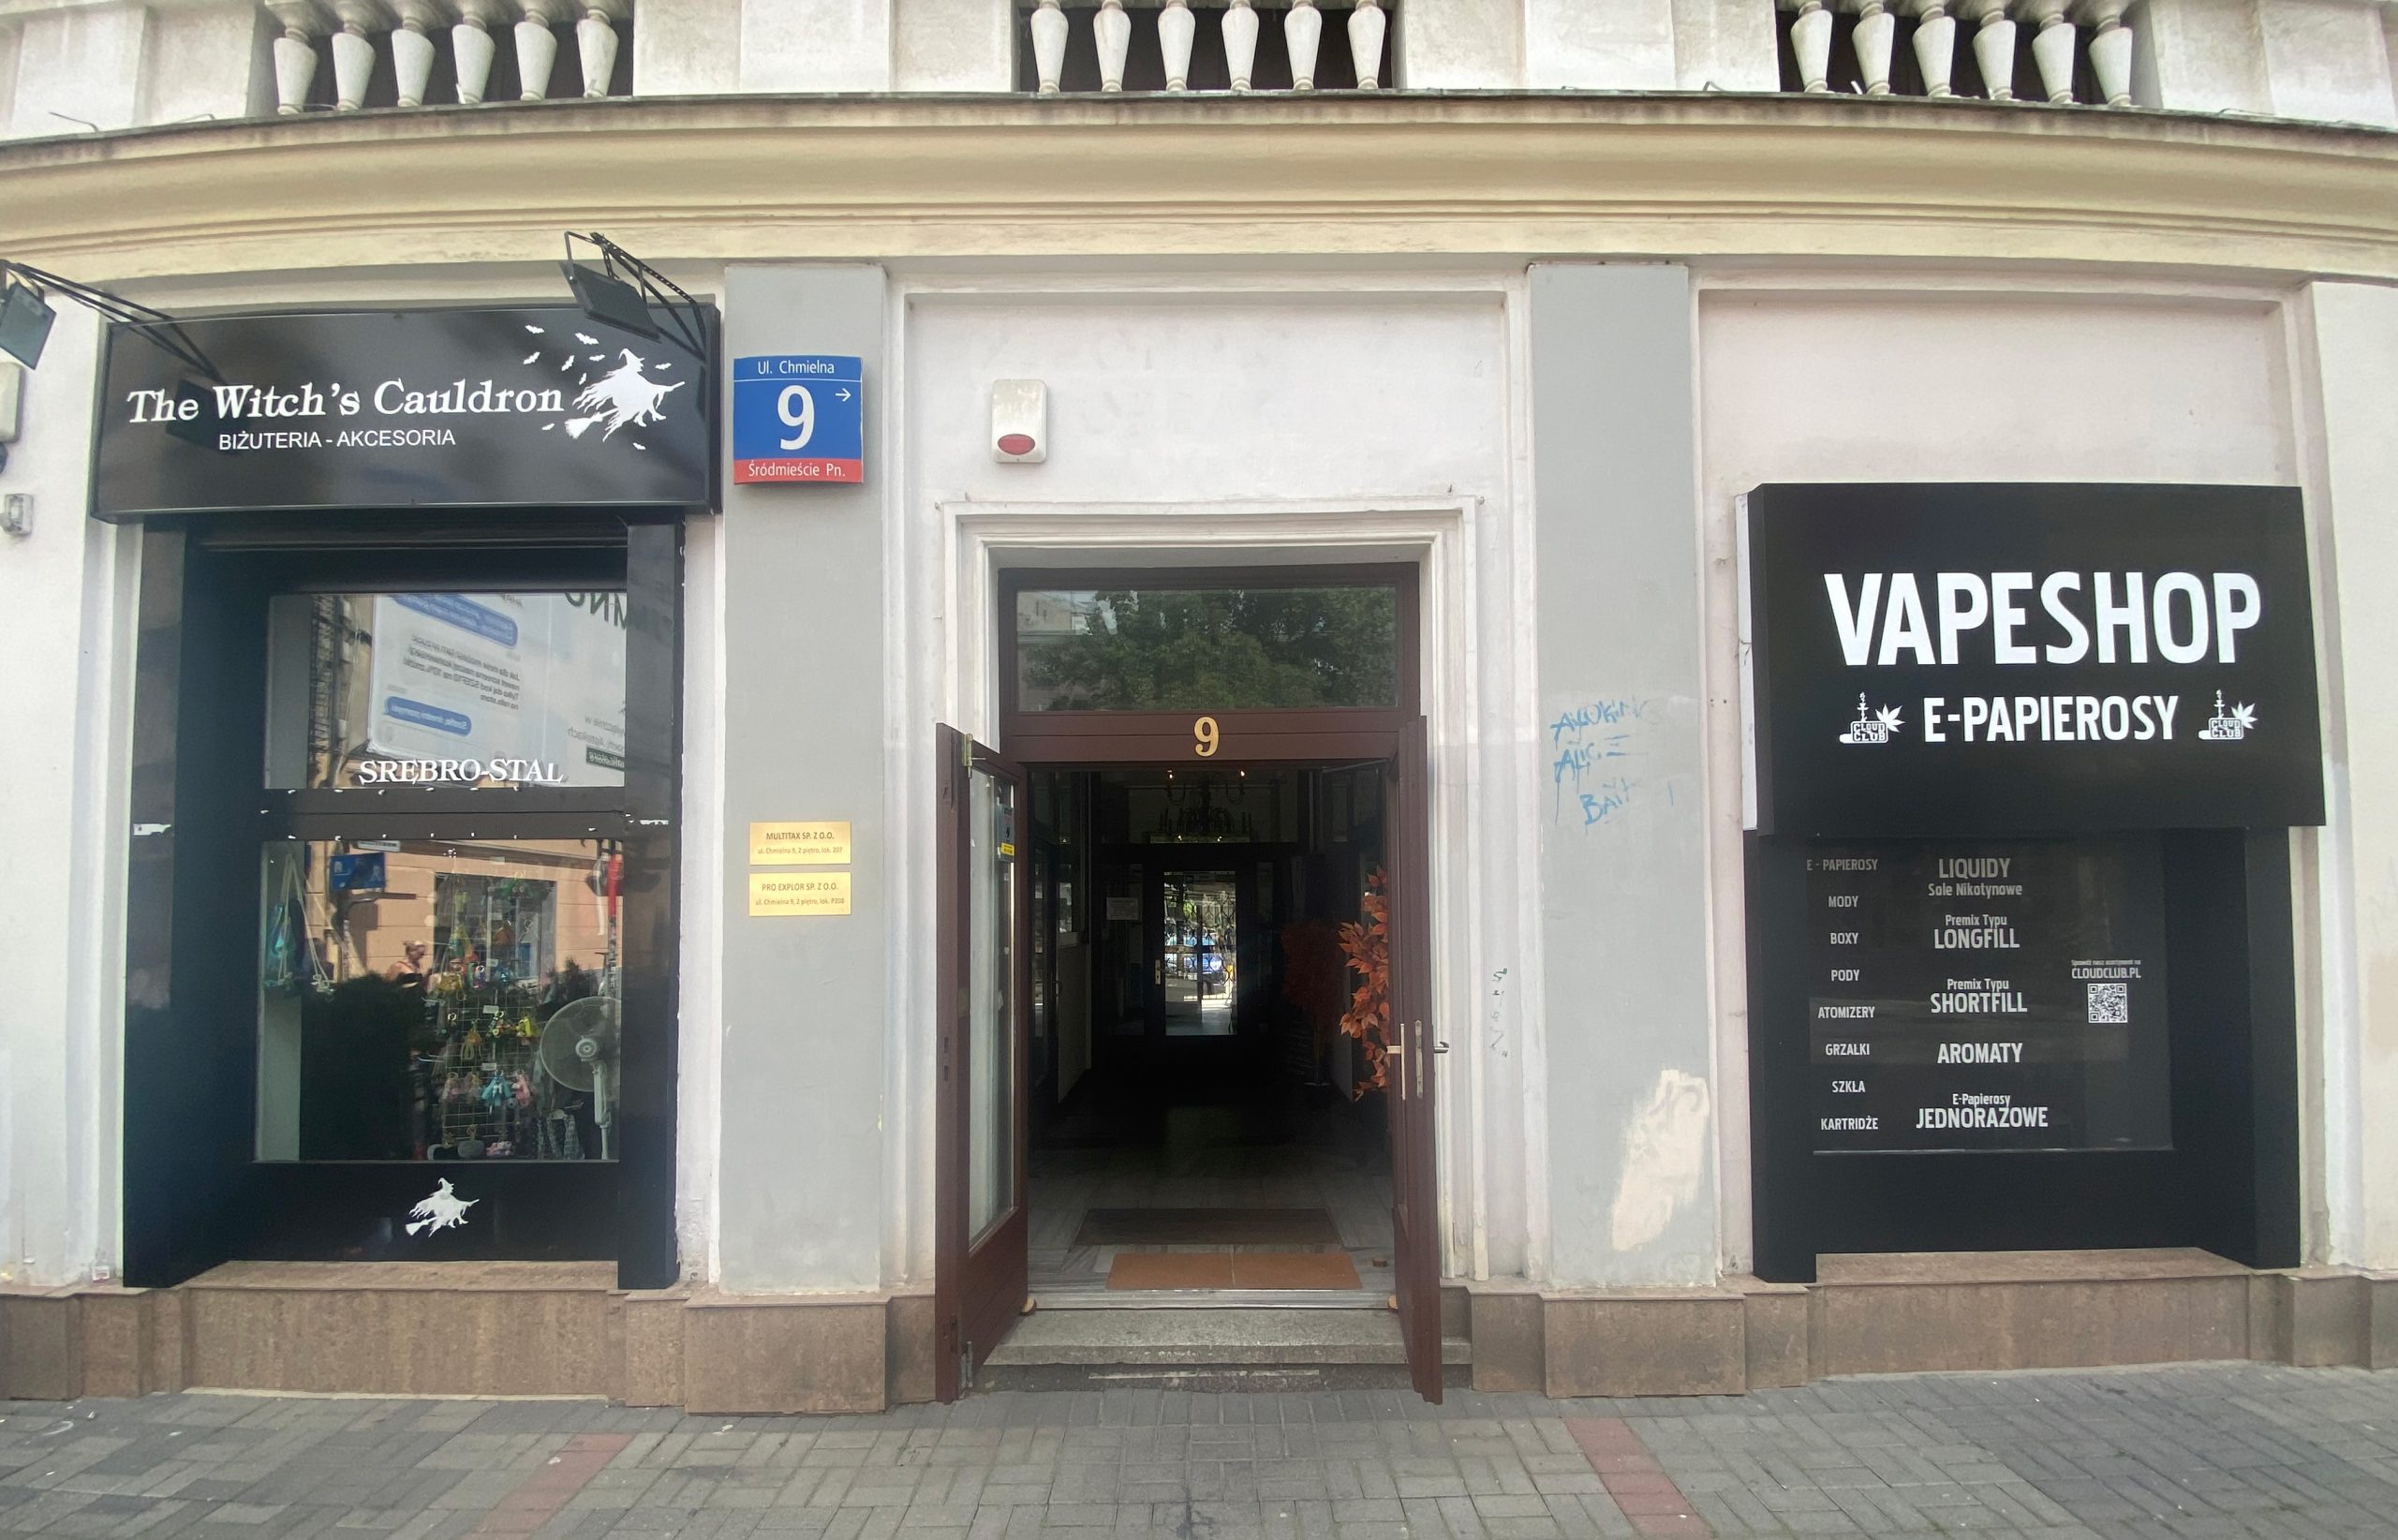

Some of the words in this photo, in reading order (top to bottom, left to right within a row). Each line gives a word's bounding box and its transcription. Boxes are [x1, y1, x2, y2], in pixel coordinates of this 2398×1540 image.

[758, 361, 773, 375] Ul.
[779, 360, 835, 374] Chmielna
[126, 388, 200, 422] The
[375, 378, 565, 415] Cauldron
[777, 384, 815, 451] 9
[219, 430, 322, 451] BIŻUTERIA
[336, 429, 456, 447] AKCESORIA
[748, 460, 820, 477] Śródmieście
[826, 463, 846, 477] Pn.
[1824, 570, 2261, 666] VAPESHOP
[1923, 695, 2179, 743] E-PAPIEROSY
[2211, 719, 2241, 729] CLOUD
[1853, 723, 1886, 732] CLOUD
[2211, 729, 2241, 737] CLUB
[1193, 716, 1220, 757] 9
[1853, 733, 1886, 742] CLUB
[359, 758, 564, 785] SREBRO-STAL
[765, 832, 801, 840] MULTITAX
[802, 832, 812, 840] SP.
[819, 831, 835, 839] O.O.
[1806, 859, 1813, 871] E
[1822, 858, 1878, 871] PAPIEROSY
[1938, 857, 2011, 880] LIQUIDY
[762, 883, 777, 892] PRO
[806, 882, 816, 891] SP.
[817, 882, 822, 891] Z
[822, 882, 838, 891] O.O.
[1956, 882, 2023, 899] Nikotynowe
[1828, 895, 1859, 908] MODY
[1945, 913, 1980, 926] Premix
[1982, 914, 2007, 928] Typu
[1829, 932, 1859, 945] BOXY
[1933, 928, 2021, 949] LONGFILL
[1830, 969, 1860, 982] PODY
[1947, 978, 1982, 990] Premix
[1983, 978, 2009, 993] Typu
[1930, 992, 2028, 1014] SHORTFILL
[1817, 1005, 1875, 1019] ATOMIZERY
[1937, 1042, 2023, 1064] AROMATY
[1952, 1092, 2011, 1107] E-Papierosy
[1820, 1115, 1879, 1131] KARTRIDŻE
[1916, 1106, 2049, 1129] JEDNORAZOWE
